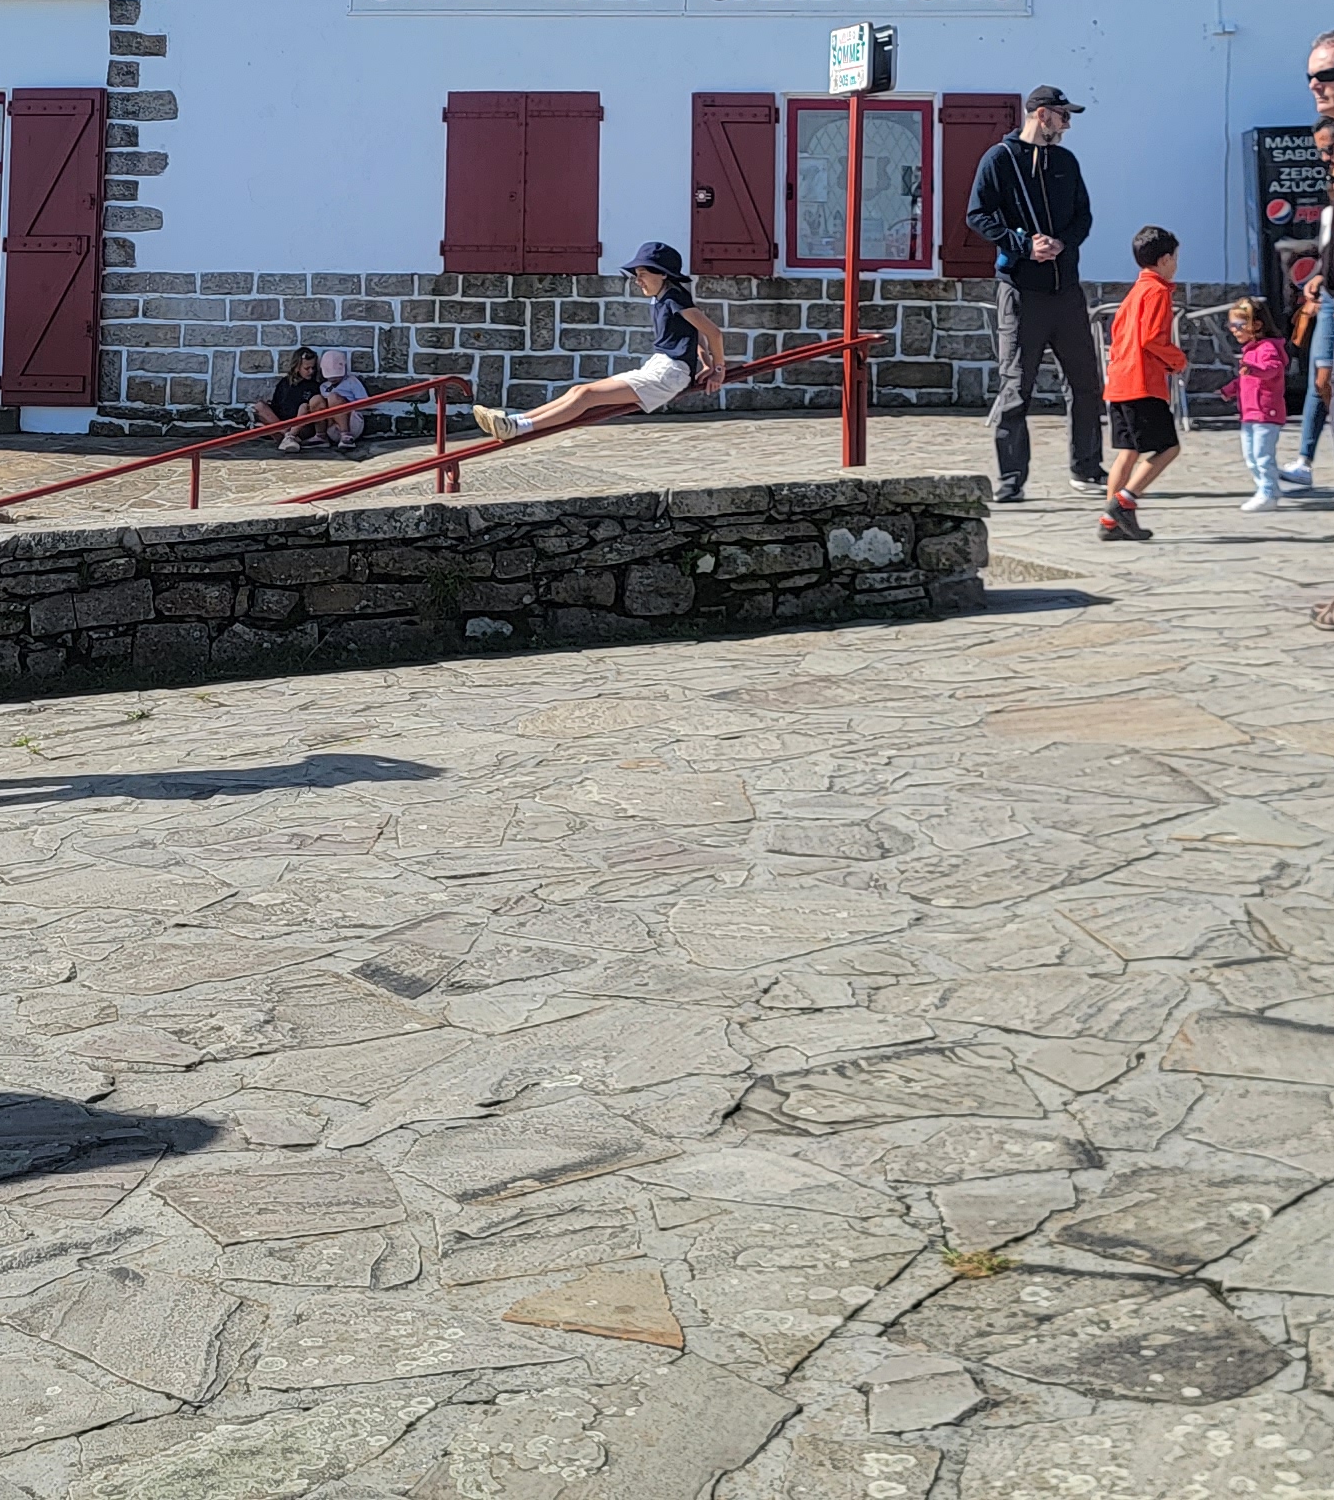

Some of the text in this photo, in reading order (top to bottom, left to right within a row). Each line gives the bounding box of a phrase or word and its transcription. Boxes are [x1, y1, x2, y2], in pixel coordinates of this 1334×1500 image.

[832, 42, 866, 66] SOMMET
[1264, 135, 1315, 148] MÁXI
[1272, 149, 1319, 161] SABO
[1279, 167, 1326, 179] ZERO
[1269, 180, 1328, 193] AZÚCA
